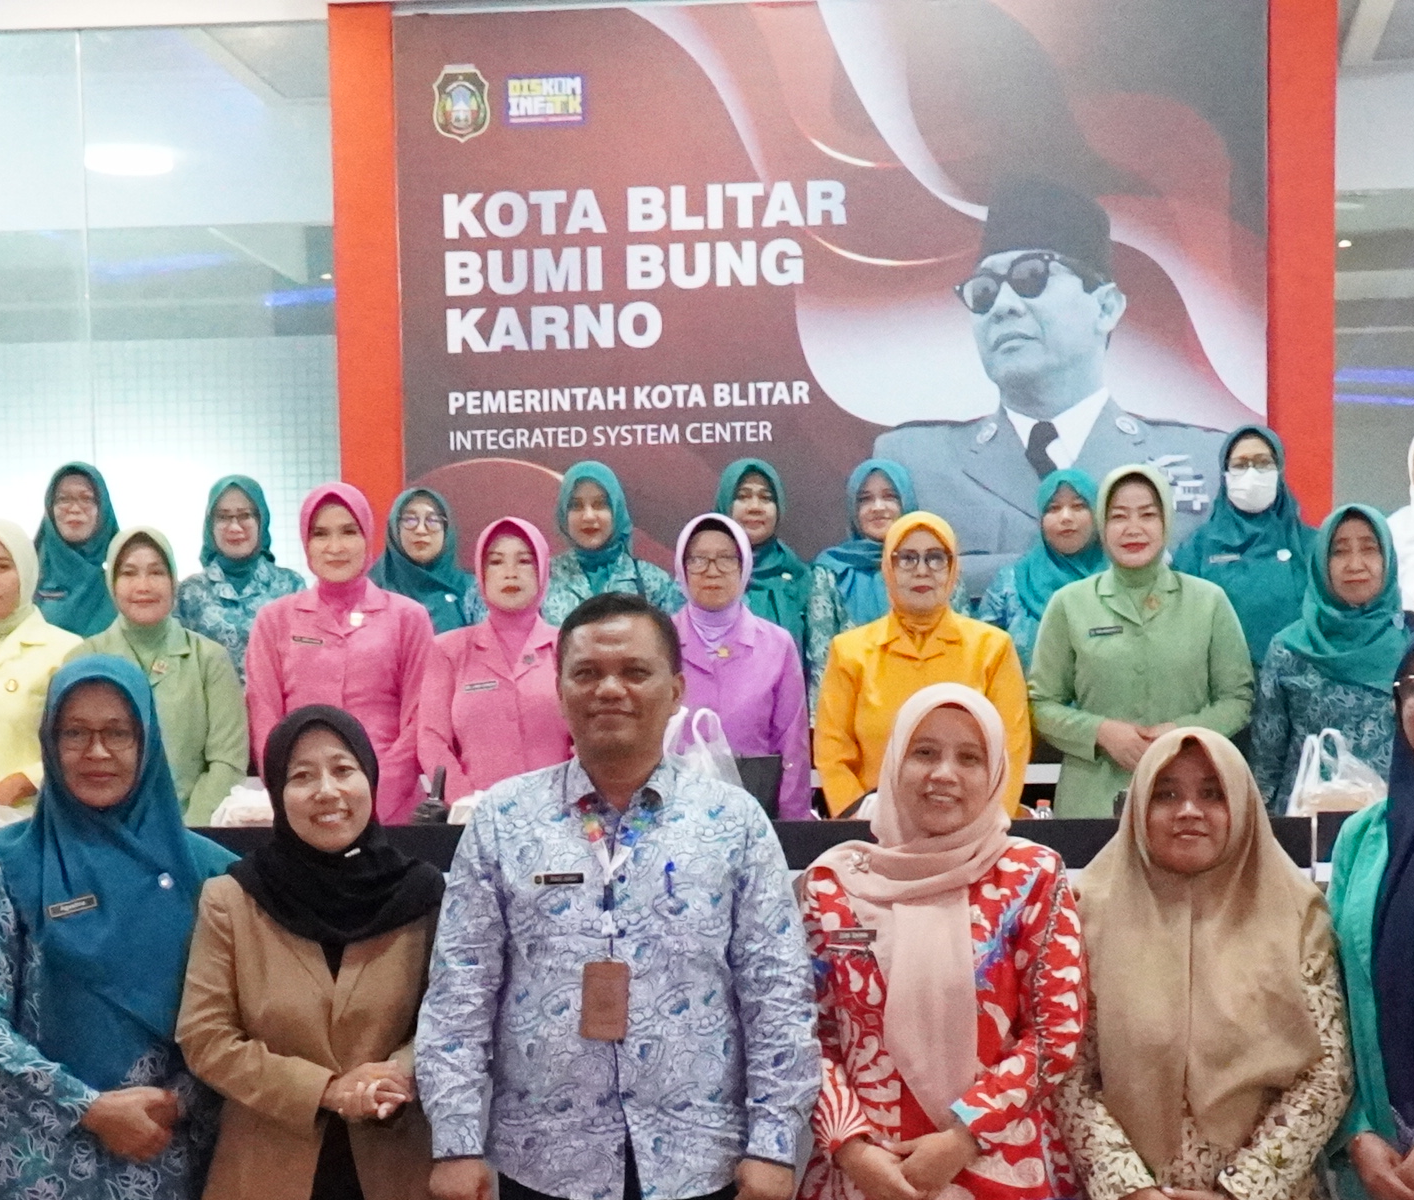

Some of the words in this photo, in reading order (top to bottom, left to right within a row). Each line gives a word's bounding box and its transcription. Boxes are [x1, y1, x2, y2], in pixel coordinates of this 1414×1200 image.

[442, 188, 607, 239] KOTA
[627, 179, 847, 232] BLITAR
[444, 245, 603, 296] BUMI
[626, 238, 804, 291] BUNG
[445, 301, 663, 354] KARNO
[448, 387, 626, 416] PEMERINTAH
[634, 384, 707, 410] KOTA
[713, 380, 810, 407] BLITAR
[449, 426, 587, 451] INTEGRATED
[592, 424, 680, 447] SYSTEM
[686, 421, 773, 444] CENTER
